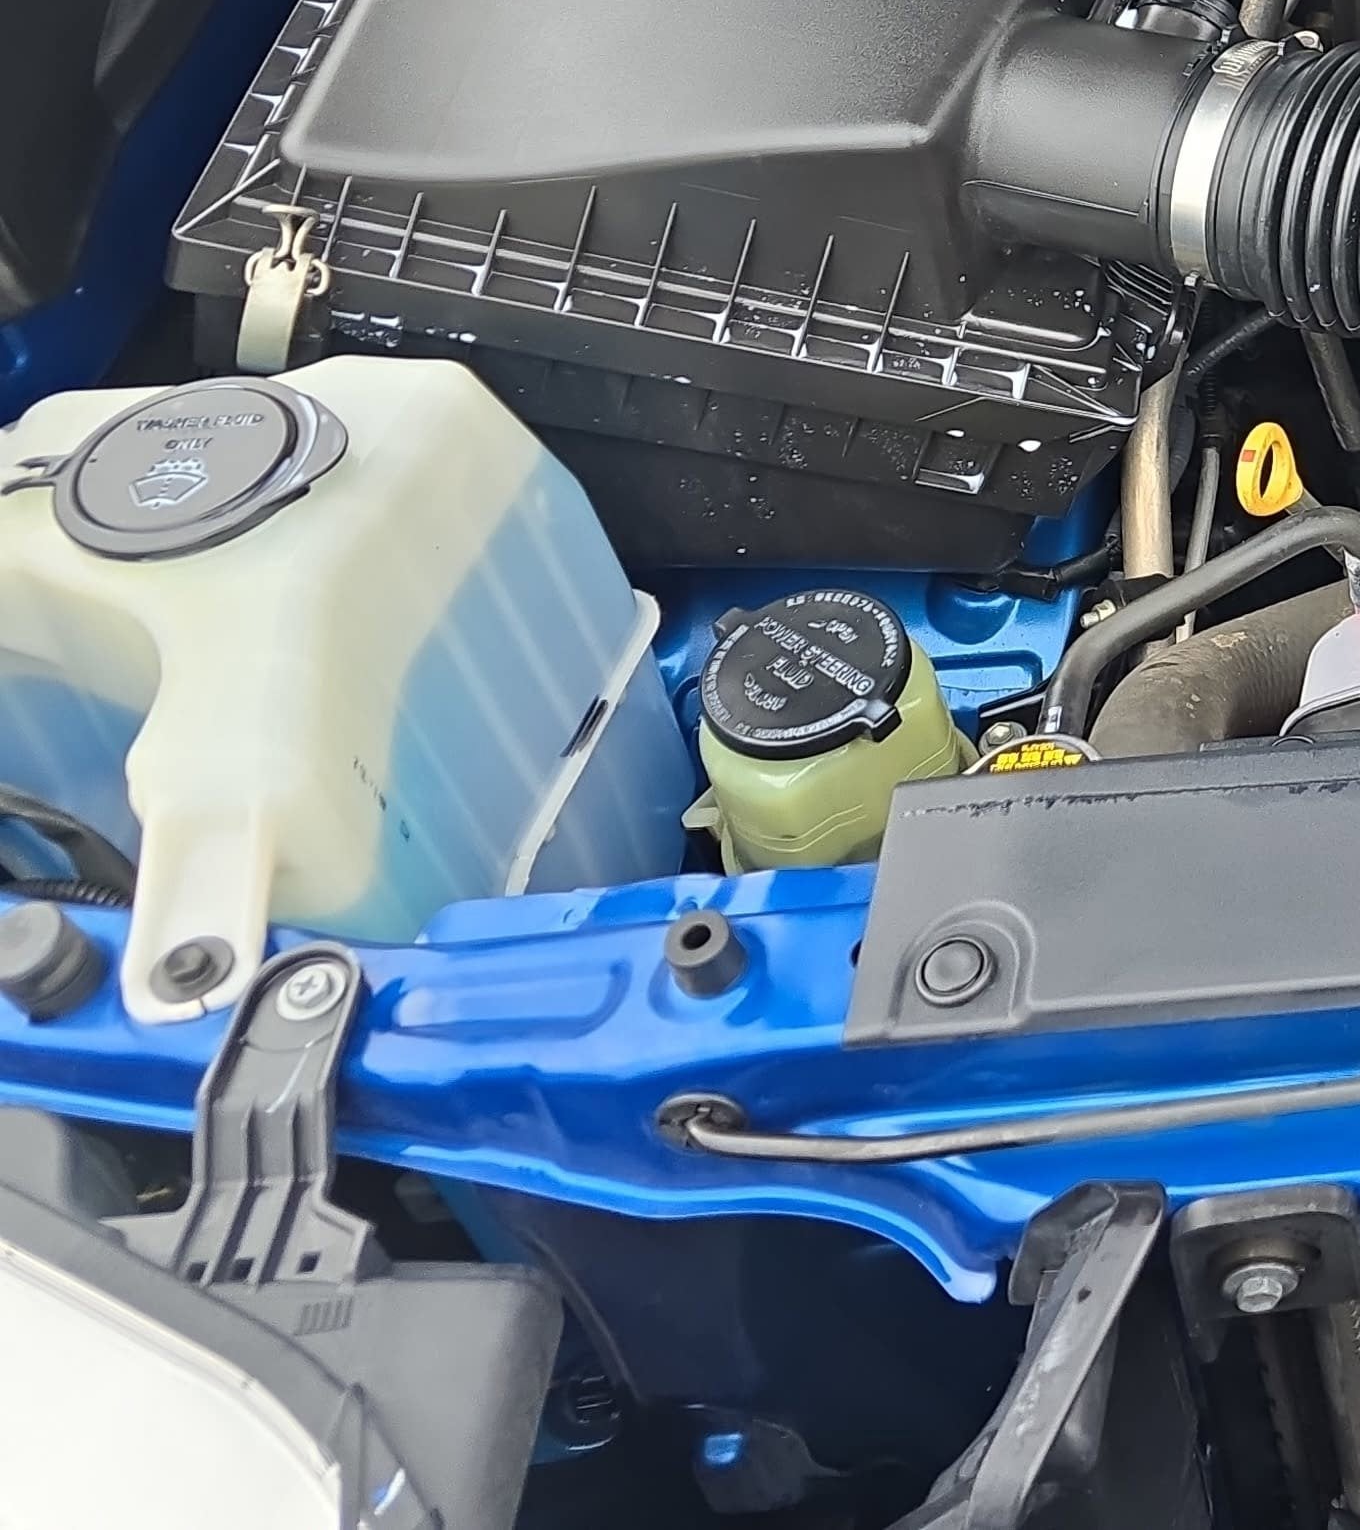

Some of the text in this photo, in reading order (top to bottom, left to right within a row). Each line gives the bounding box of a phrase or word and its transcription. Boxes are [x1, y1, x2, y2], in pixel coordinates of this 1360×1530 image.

[213, 413, 265, 427] FLUID
[164, 436, 213, 451] ONLY
[754, 616, 808, 654] POWER
[801, 646, 875, 696] STEERING
[766, 656, 815, 690] FLUID
